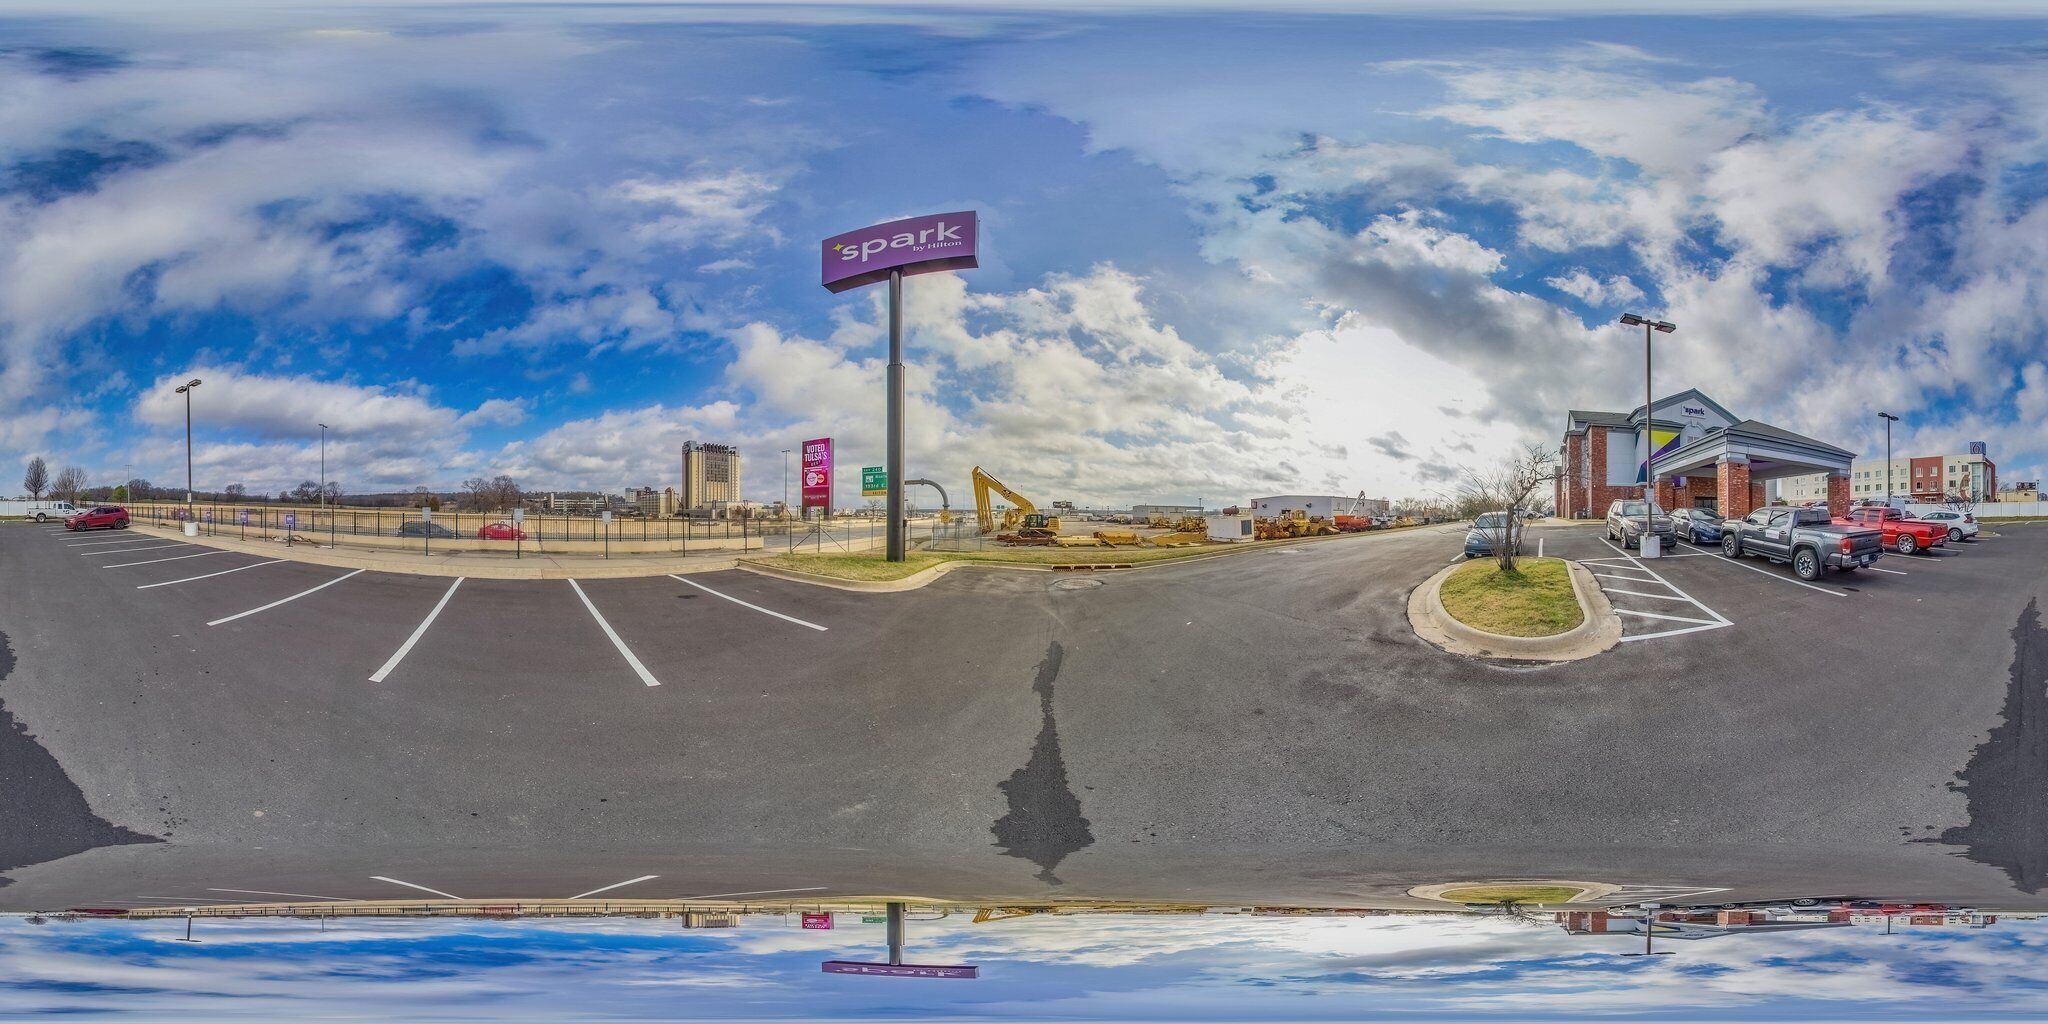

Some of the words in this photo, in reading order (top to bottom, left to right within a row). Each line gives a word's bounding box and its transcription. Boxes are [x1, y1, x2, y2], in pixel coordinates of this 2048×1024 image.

[841, 221, 963, 263] spark
[927, 240, 962, 249] Hilton
[1685, 407, 1705, 415] spark
[807, 444, 825, 453] VOTED
[805, 452, 828, 462] TULSA'S
